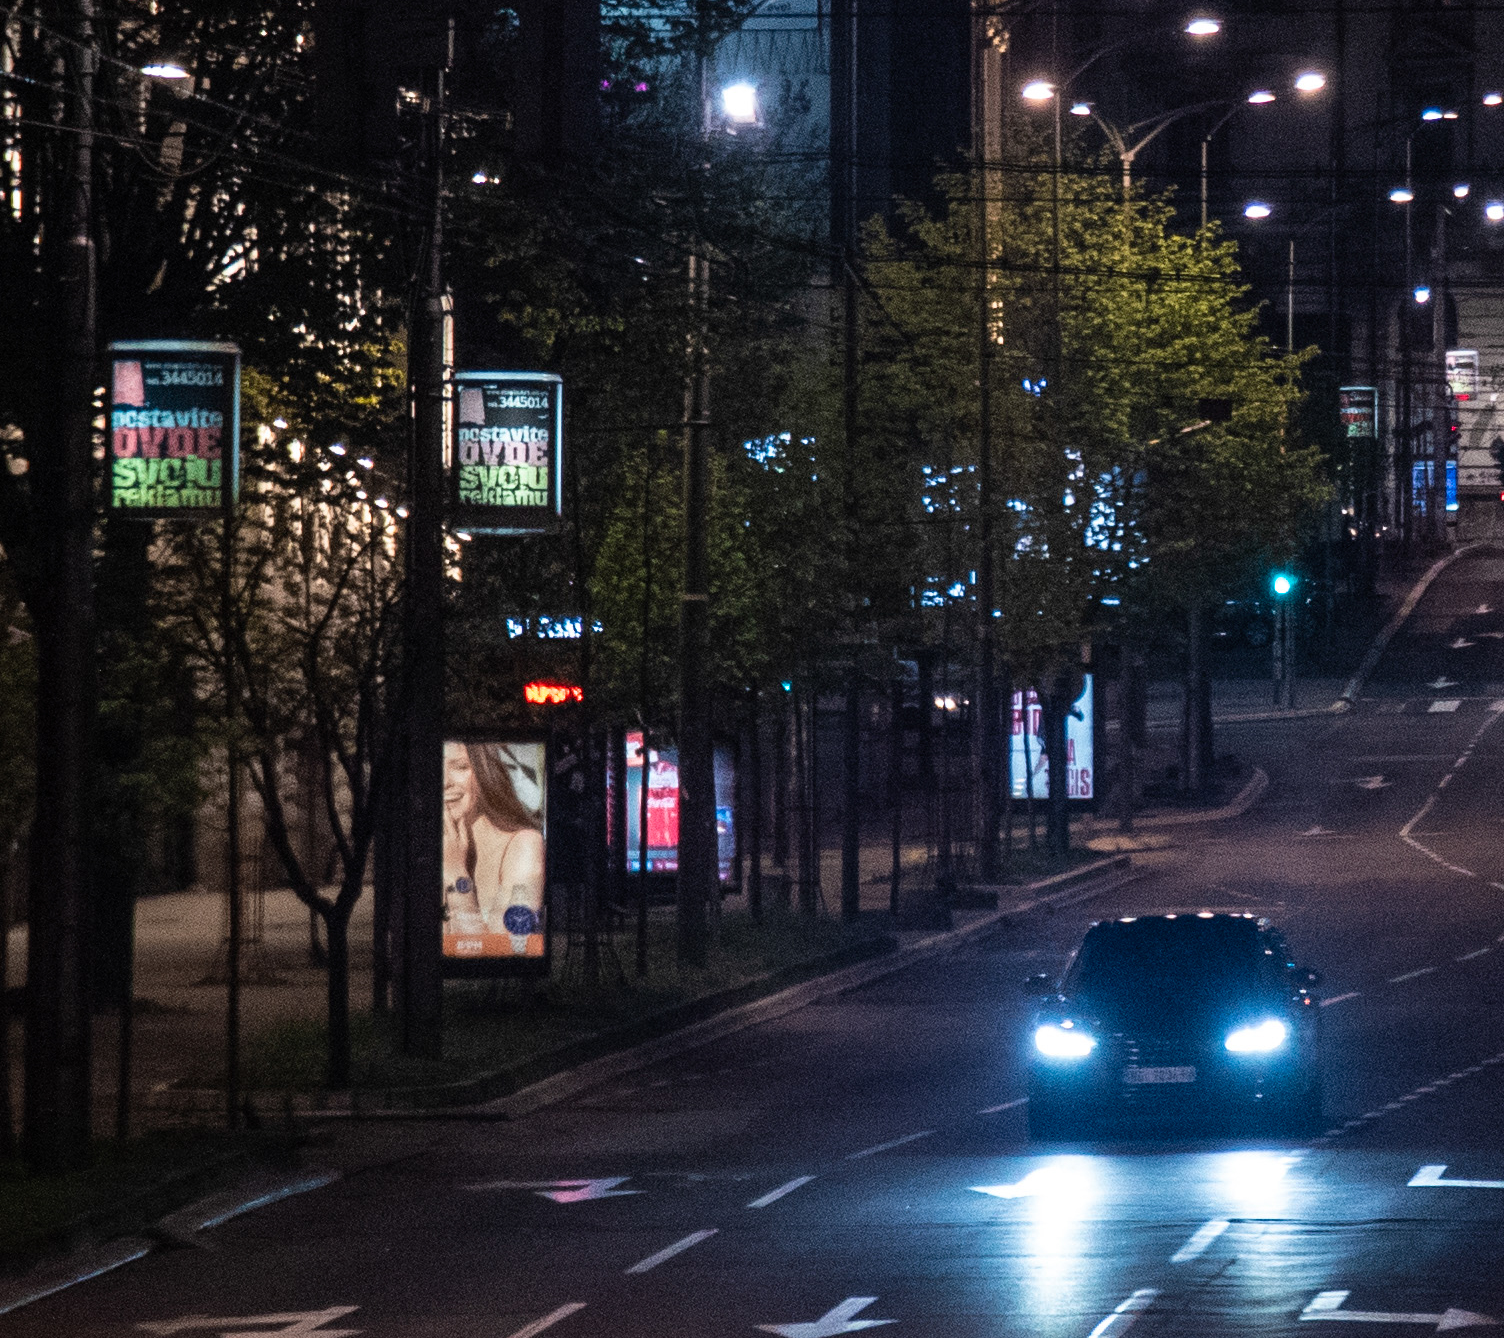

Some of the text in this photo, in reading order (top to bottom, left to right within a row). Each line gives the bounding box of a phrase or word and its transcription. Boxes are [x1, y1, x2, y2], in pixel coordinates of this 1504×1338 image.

[499, 396, 549, 409] 3445014
[113, 427, 222, 459] OVDE
[459, 440, 549, 466] OVDE
[459, 483, 549, 506] reklamu
